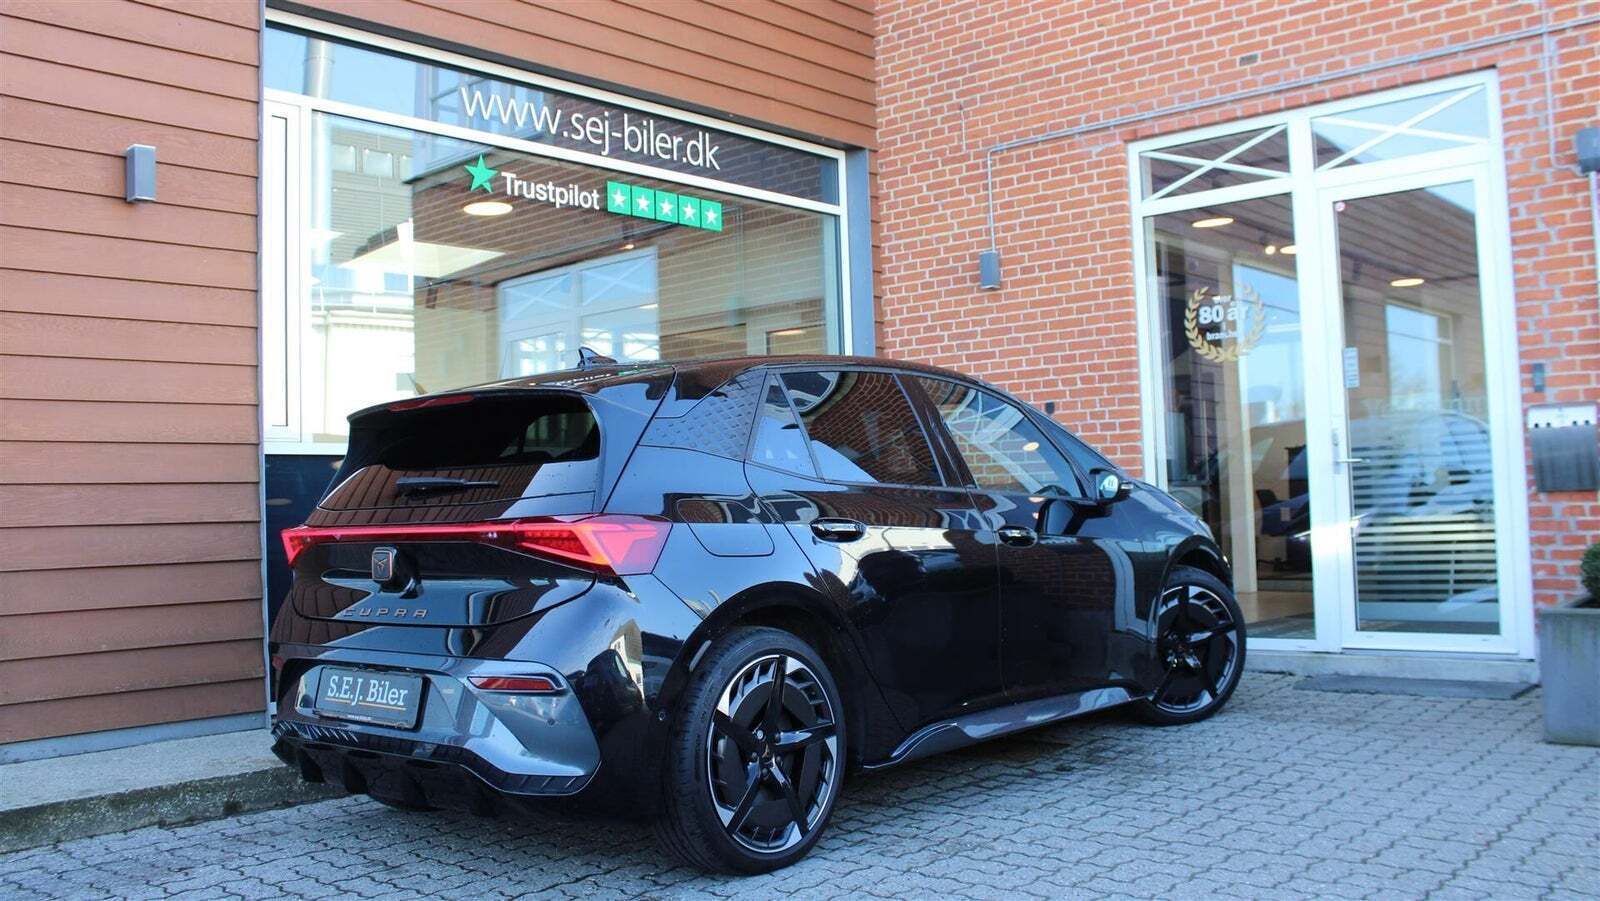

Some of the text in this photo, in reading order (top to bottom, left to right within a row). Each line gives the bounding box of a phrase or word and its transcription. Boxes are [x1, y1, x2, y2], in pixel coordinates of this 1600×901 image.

[461, 87, 720, 170] www.sej-biler.dk
[501, 171, 600, 210] Trustpilot
[1198, 304, 1224, 324] 80
[342, 607, 428, 618] CUPRA
[327, 675, 409, 706] S.E.J. Biler
